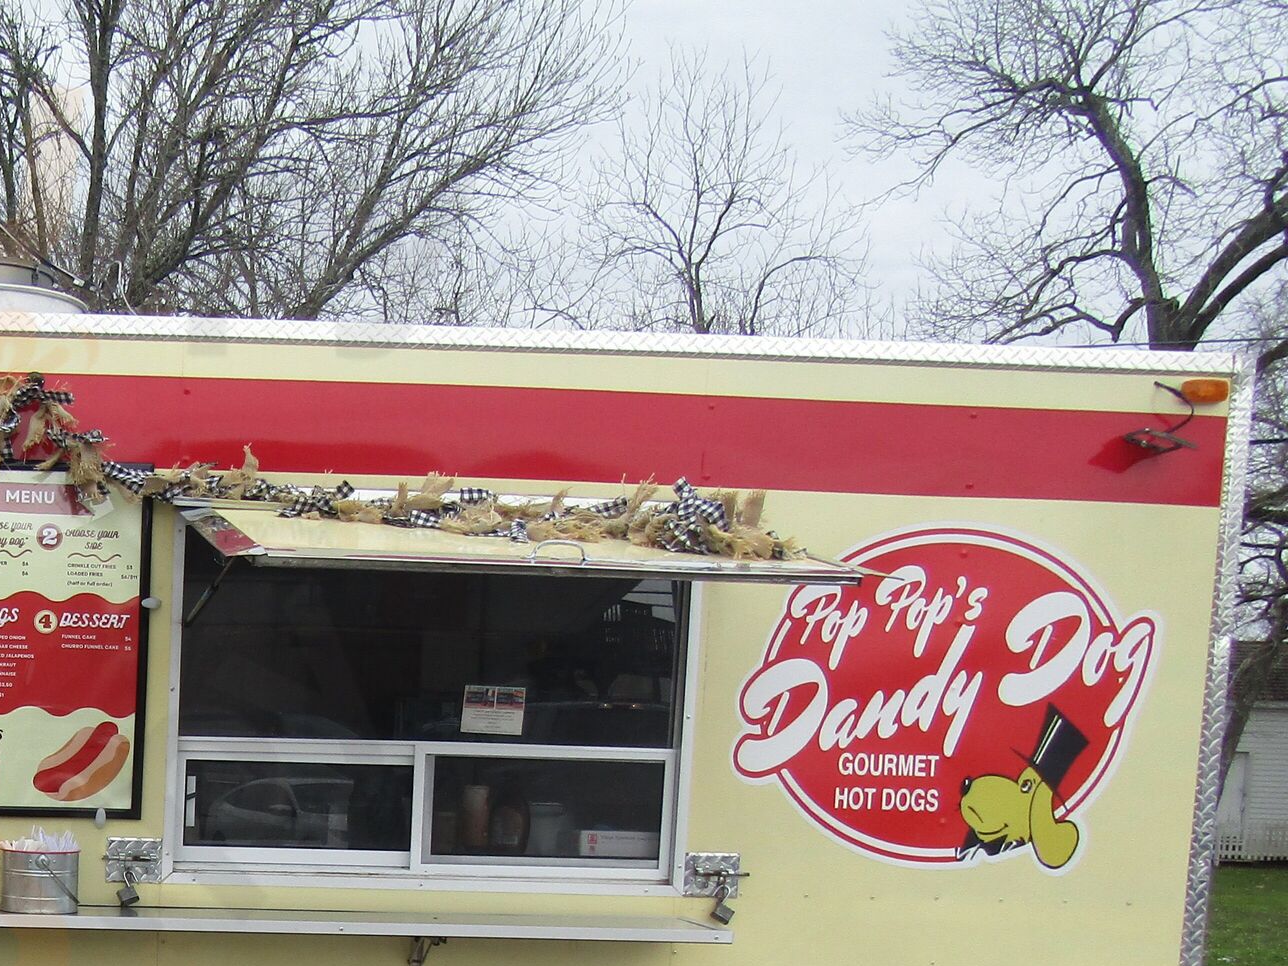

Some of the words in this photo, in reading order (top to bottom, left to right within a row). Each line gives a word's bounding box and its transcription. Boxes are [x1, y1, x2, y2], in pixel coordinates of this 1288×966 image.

[6, 490, 54, 504] MENU
[10, 522, 33, 532] YOUR
[65, 529, 96, 538] CHOOSE
[97, 531, 120, 541] YOUR
[42, 528, 58, 544] 2
[84, 541, 103, 550] SIDE
[38, 614, 53, 629] 4
[59, 612, 131, 629] DESSERT
[791, 584, 869, 671] Pop
[875, 565, 989, 657] Pop's
[736, 624, 983, 771] Dandy
[998, 592, 1153, 728] Dog
[838, 752, 940, 777] GOURMET
[834, 788, 872, 810] HOT
[881, 788, 939, 812] DOGS
